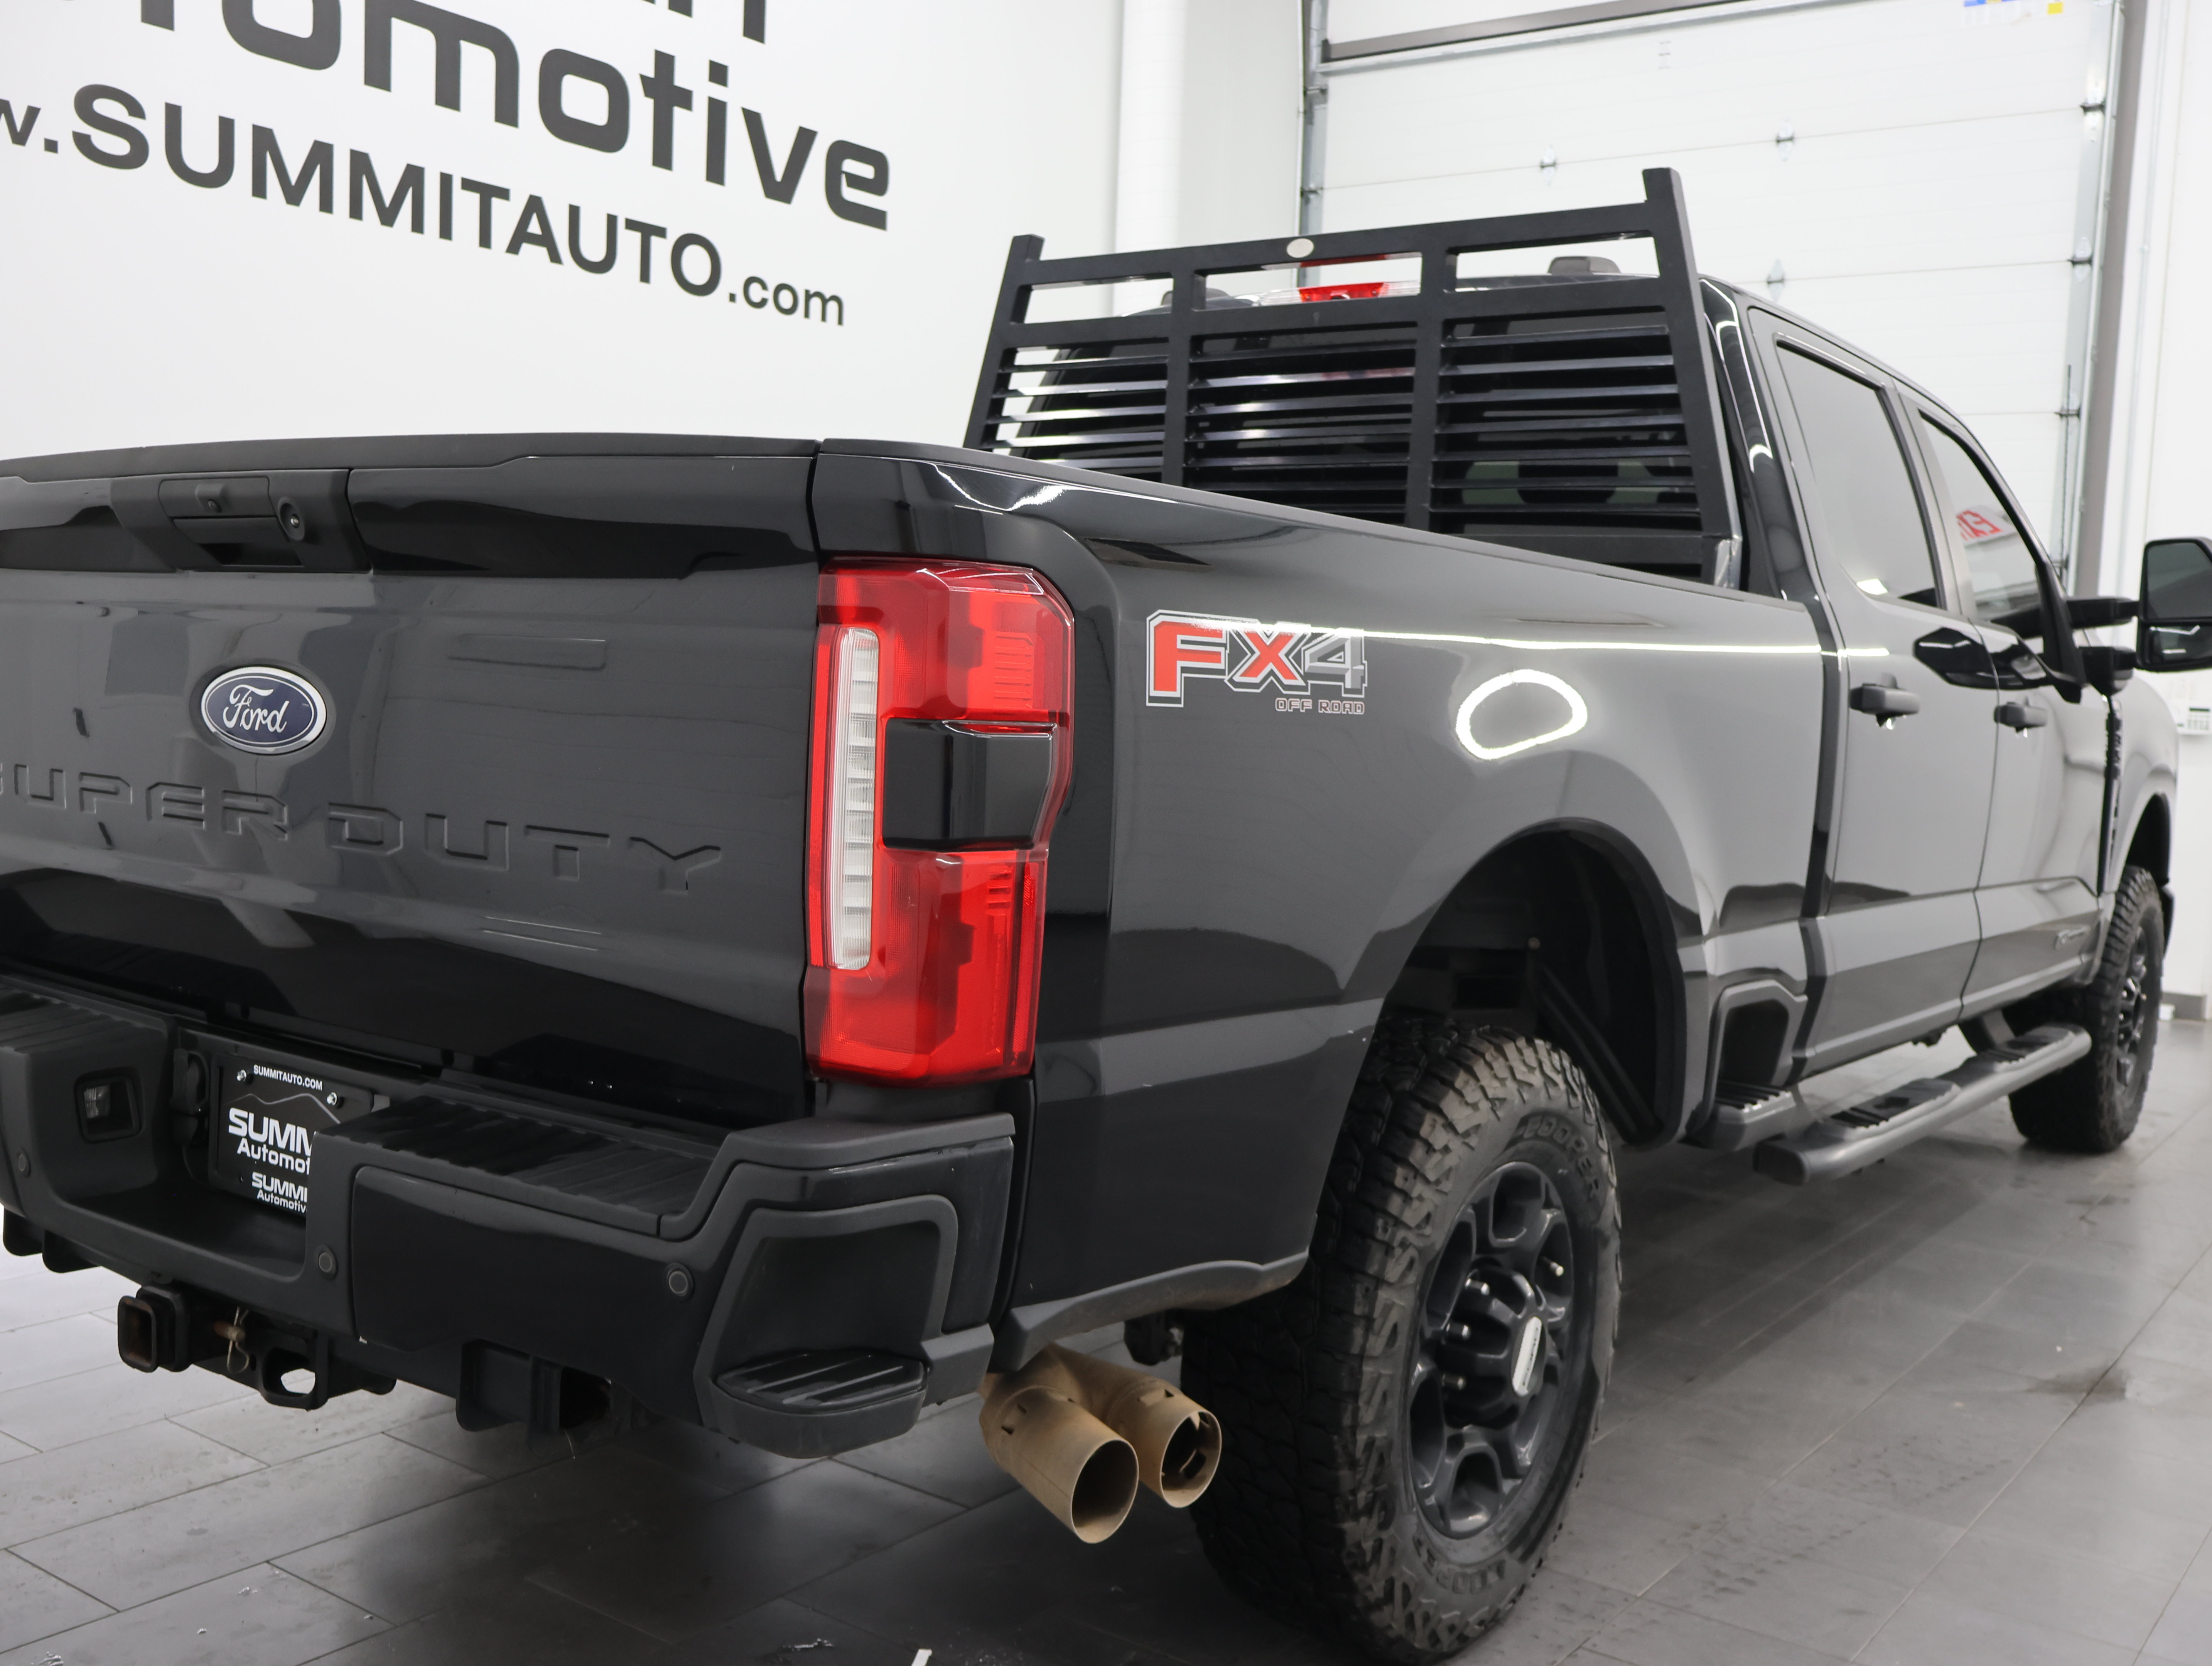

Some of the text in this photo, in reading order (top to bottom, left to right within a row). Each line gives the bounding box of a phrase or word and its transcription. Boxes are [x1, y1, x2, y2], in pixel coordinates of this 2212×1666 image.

[141, 0, 889, 231] omotive
[1146, 609, 1367, 708] FX4
[223, 684, 290, 733] Ford
[1275, 697, 1365, 715] OFF ROAD
[0, 761, 721, 895] UPER DUTY
[253, 1064, 322, 1091] SUMMITAUTO.COM
[228, 1107, 317, 1157] SUMM
[237, 1137, 310, 1175] Automot
[252, 1171, 308, 1203] SUMMI
[257, 1189, 307, 1213] Automotiv
